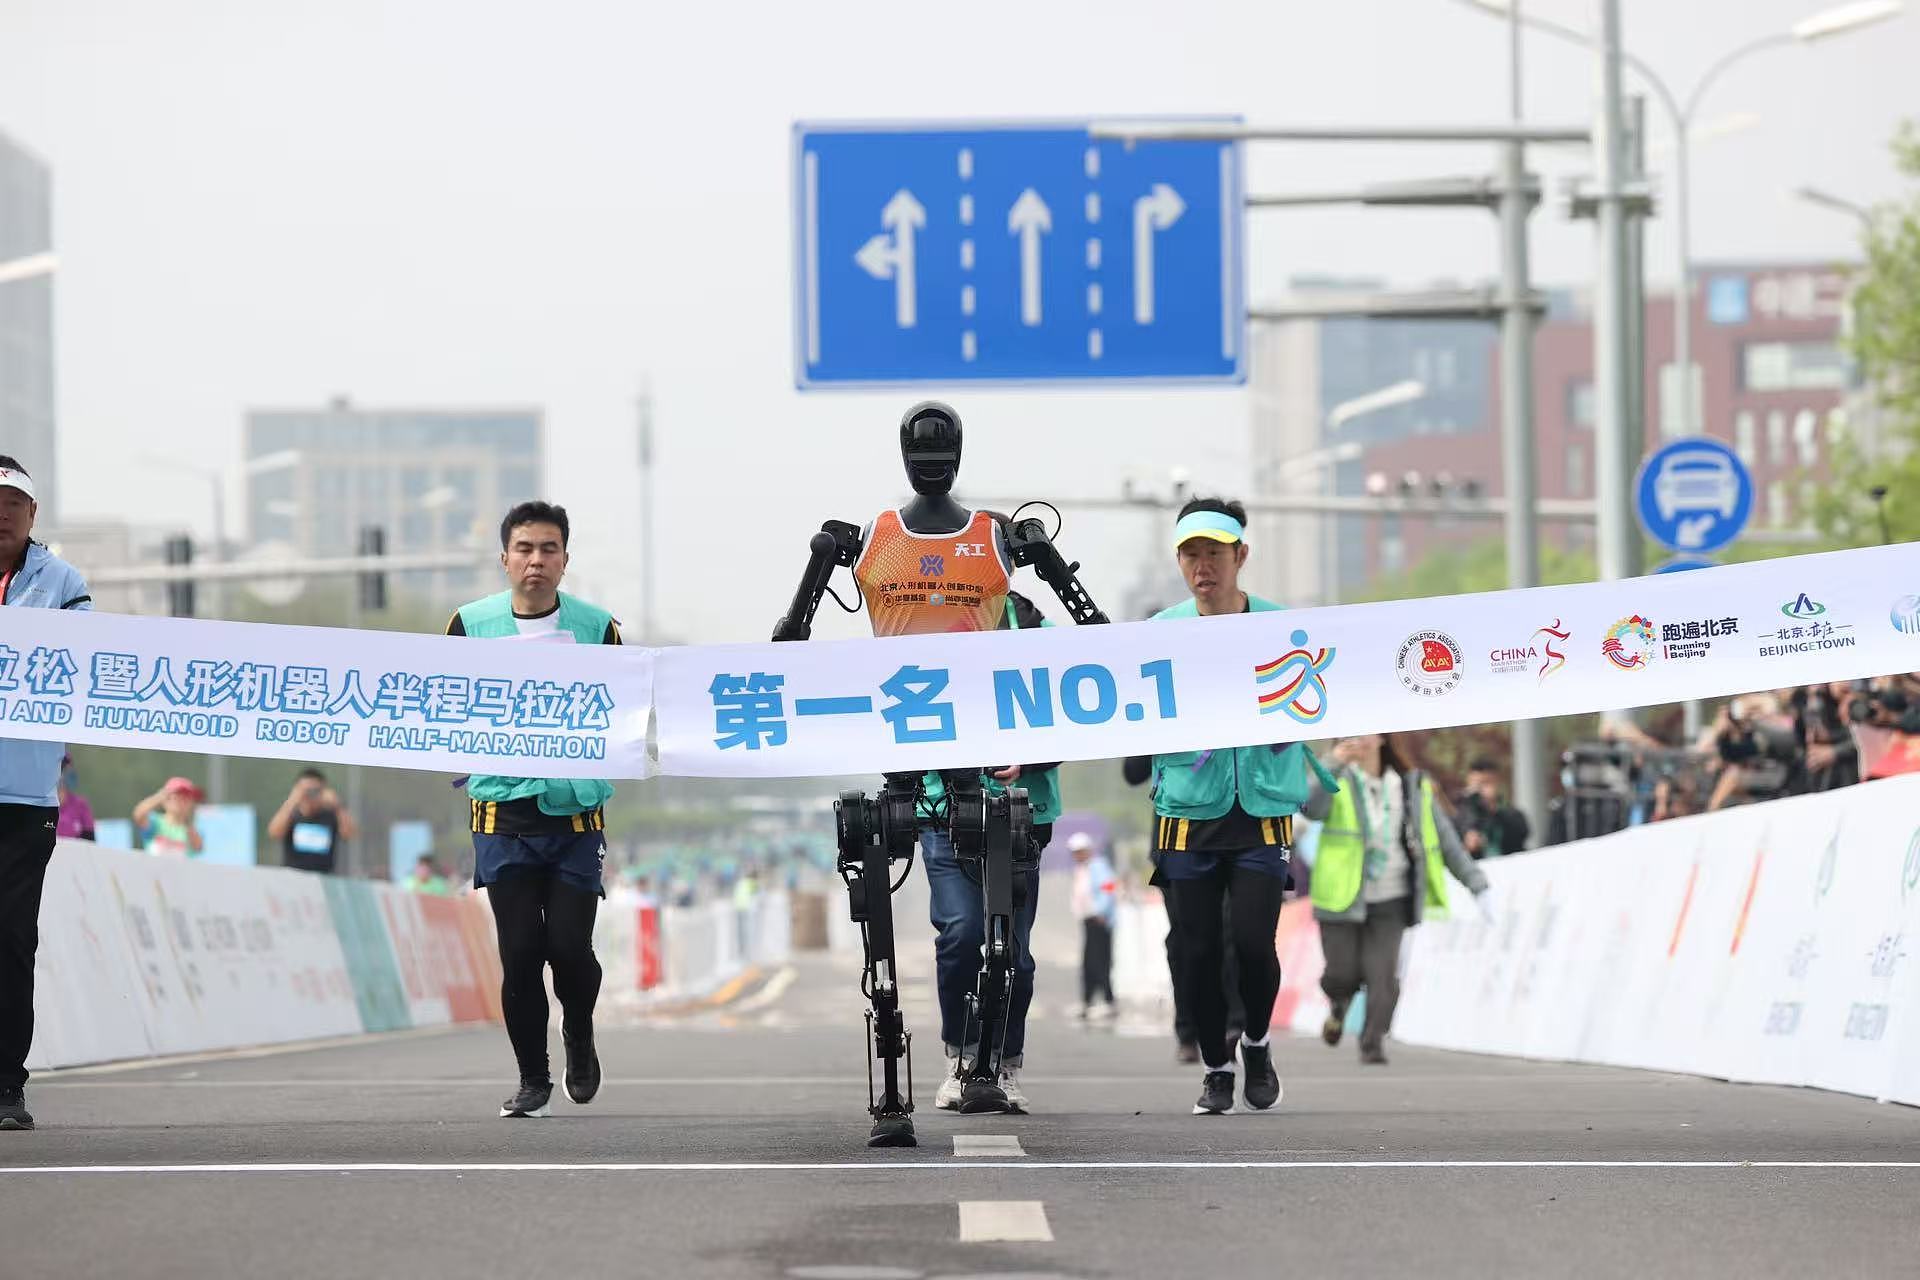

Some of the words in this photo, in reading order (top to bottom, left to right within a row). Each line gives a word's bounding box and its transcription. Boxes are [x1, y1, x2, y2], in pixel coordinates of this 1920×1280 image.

[954, 543, 987, 557] 天工
[1662, 617, 1739, 641] 跑遍北京
[1398, 645, 1410, 669] CHINESE
[1407, 632, 1436, 647] ATHLETICS
[1437, 634, 1462, 664] ASSOCIATION
[1490, 647, 1538, 661] CHINA
[1669, 641, 1711, 651] Running
[1670, 650, 1706, 659] Beijing
[88, 652, 616, 731] 暨人形机器人半程马拉松
[708, 665, 957, 750] 第一名
[993, 659, 1178, 730] NO.1
[10, 700, 73, 725] AND
[85, 705, 239, 738] HUMANOID
[256, 718, 350, 746] ROBOT
[369, 725, 606, 760] HALF-MARATHON
